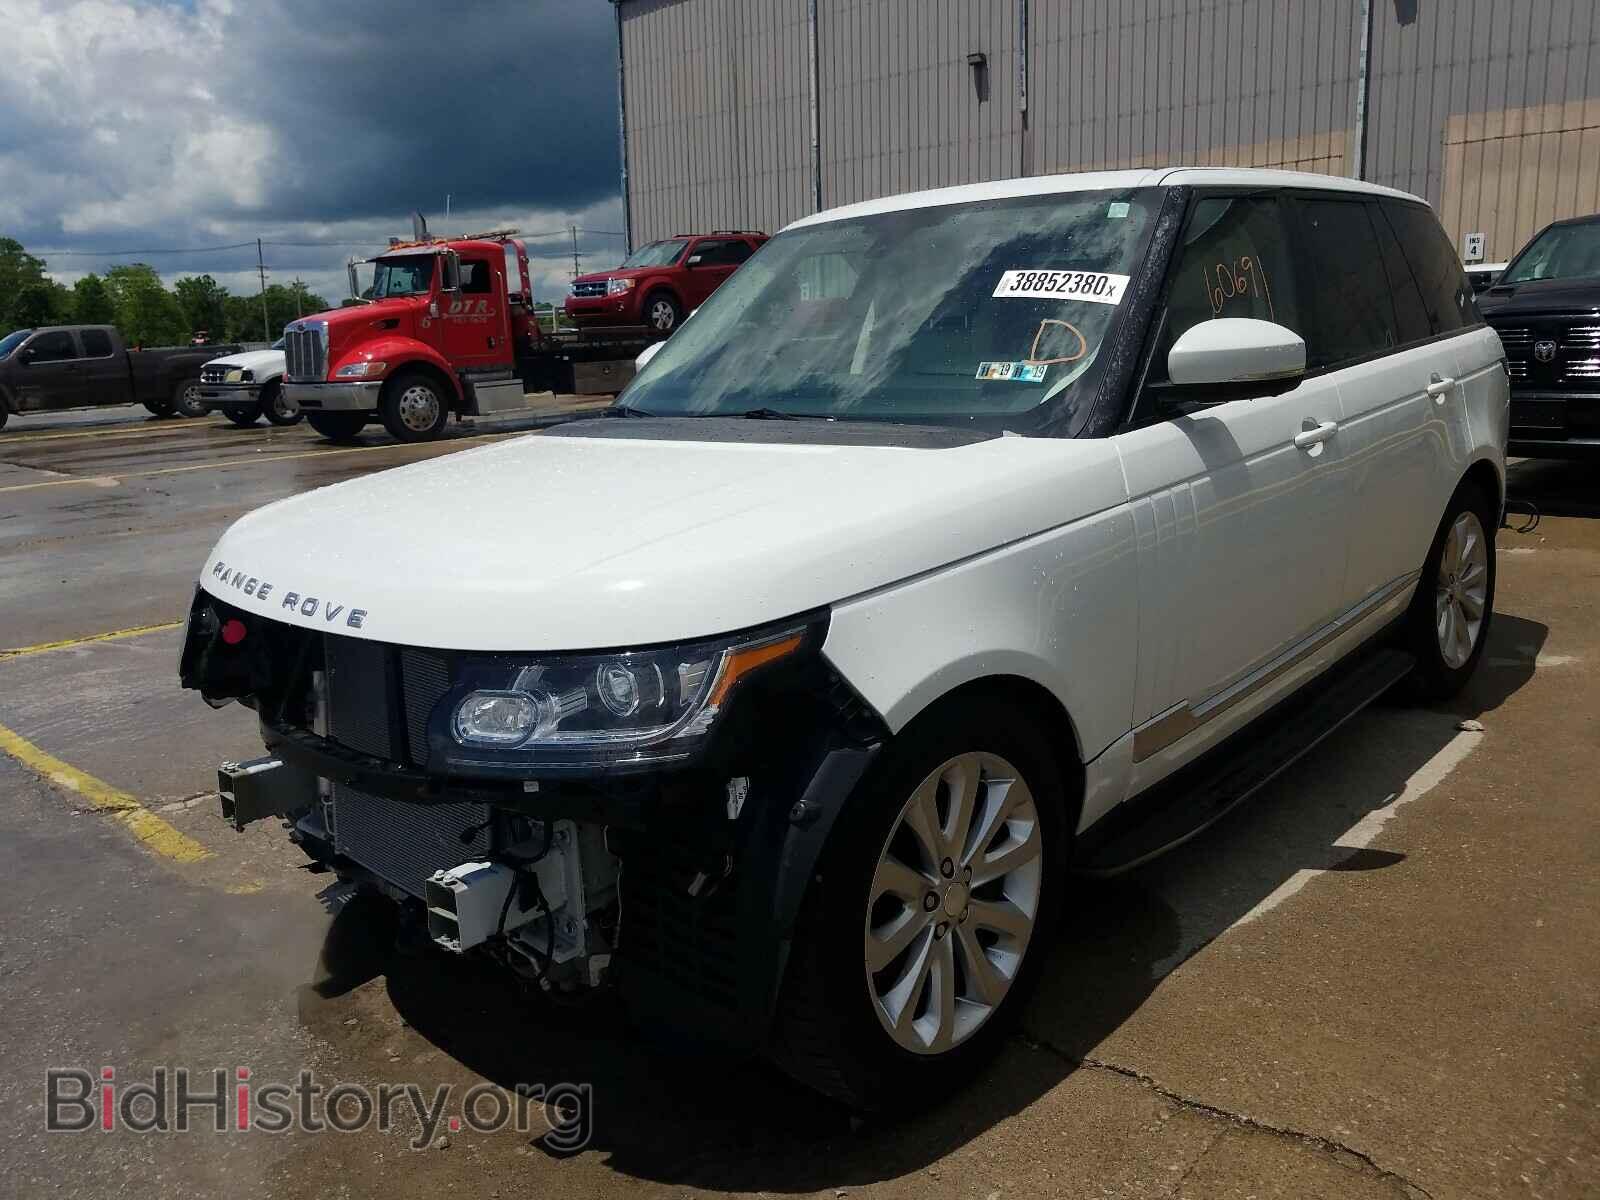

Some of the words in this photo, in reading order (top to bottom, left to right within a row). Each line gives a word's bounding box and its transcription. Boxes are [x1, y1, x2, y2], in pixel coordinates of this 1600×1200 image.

[1470, 245, 1477, 255] 4
[212, 561, 273, 601] RANGE
[281, 591, 368, 629] ROVE
